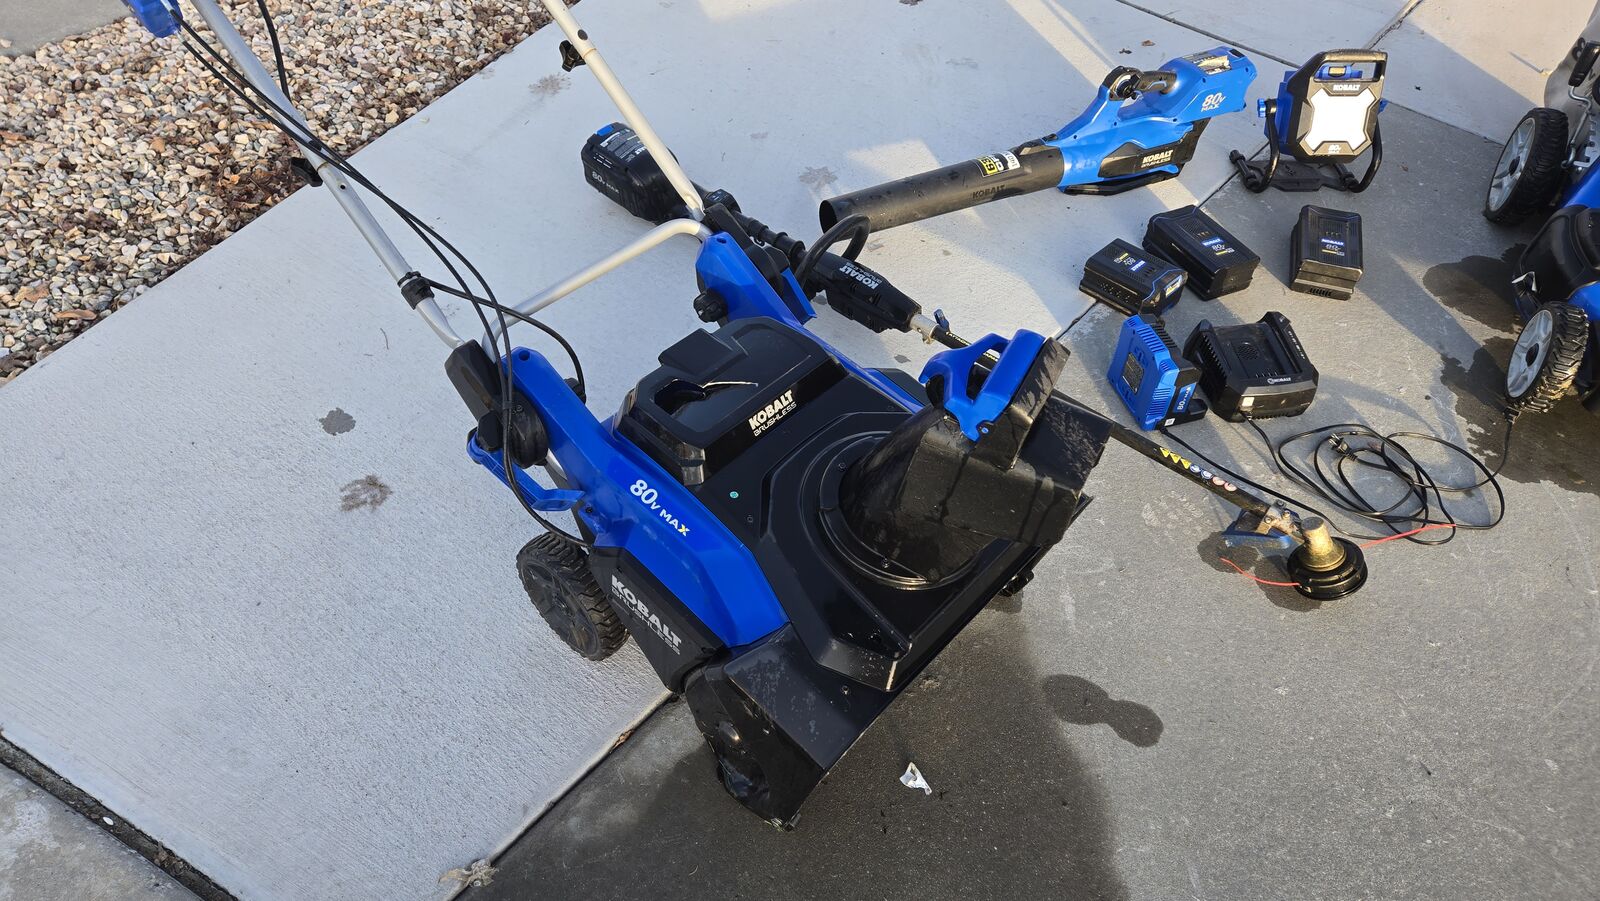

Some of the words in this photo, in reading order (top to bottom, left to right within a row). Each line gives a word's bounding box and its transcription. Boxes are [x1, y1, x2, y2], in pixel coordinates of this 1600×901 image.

[1333, 84, 1361, 92] KOBALT
[1142, 149, 1174, 164] KOBALT
[972, 184, 1006, 200] KOBALT
[839, 264, 879, 290] KOBALT
[748, 389, 793, 431] KOBALT
[753, 401, 798, 437] BRUSHLESS
[659, 508, 691, 537] MAX
[611, 574, 682, 648] KOBALT
[611, 585, 681, 656] BRUSHLESS
